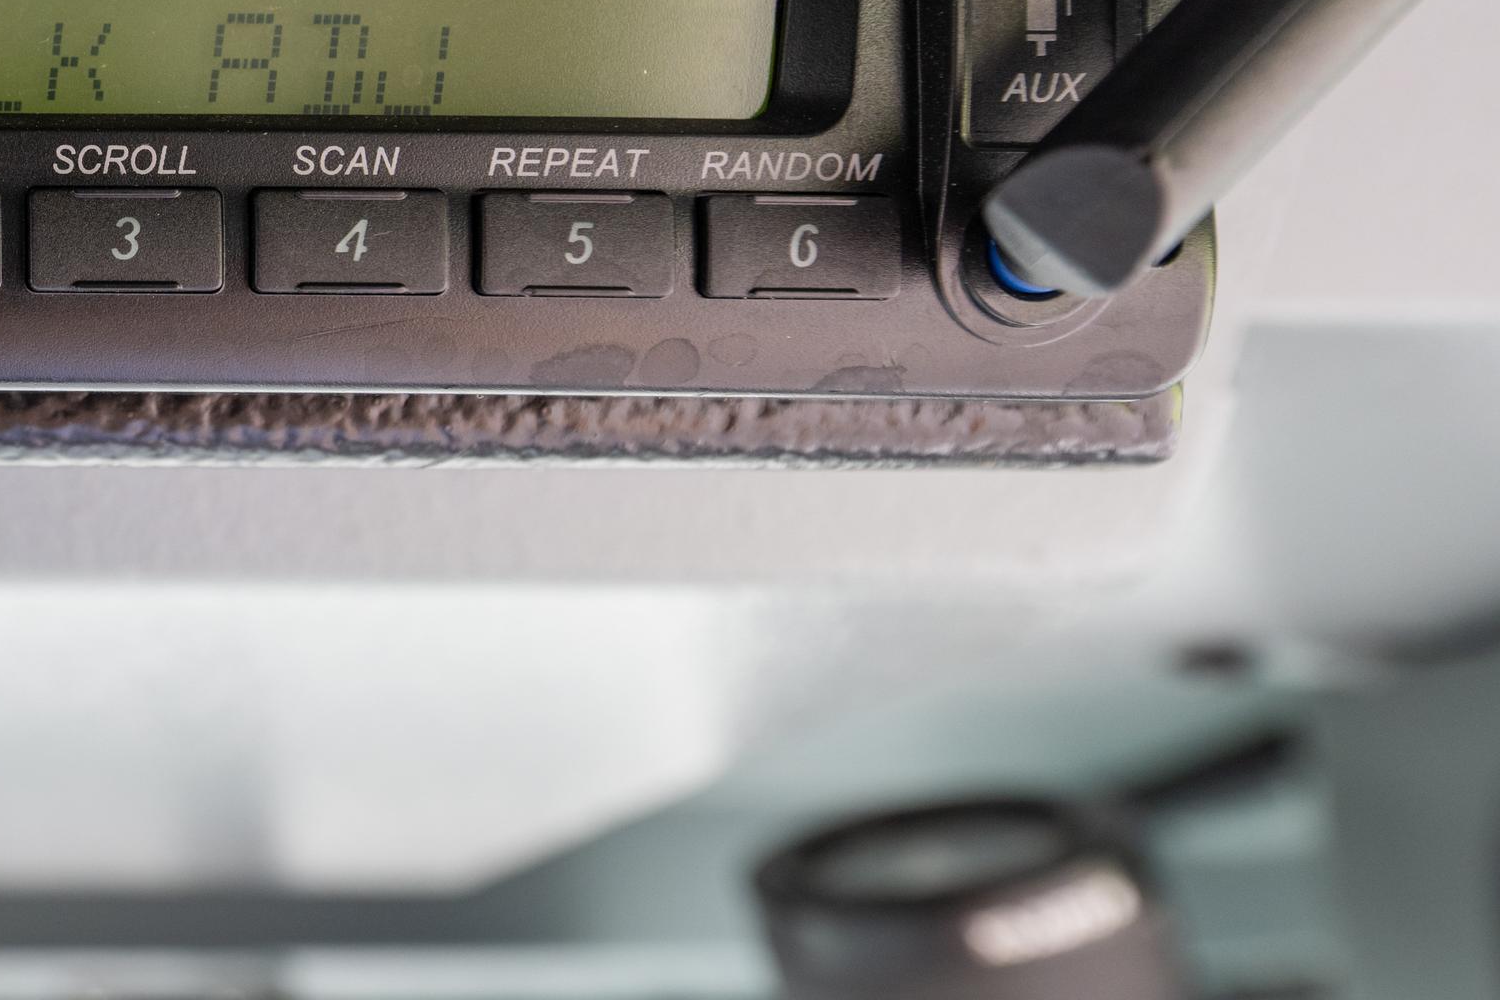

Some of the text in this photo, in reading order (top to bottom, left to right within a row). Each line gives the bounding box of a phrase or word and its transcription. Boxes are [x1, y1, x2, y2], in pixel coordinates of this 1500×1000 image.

[1001, 72, 1087, 103] AUX
[52, 143, 197, 175] SCROLL
[292, 145, 401, 176] SCAN
[488, 147, 651, 179] REPEAT
[698, 149, 881, 183] RANDOM
[111, 216, 141, 261] 3
[334, 219, 368, 262] 4
[564, 222, 594, 265] 5
[788, 224, 818, 269] 6
